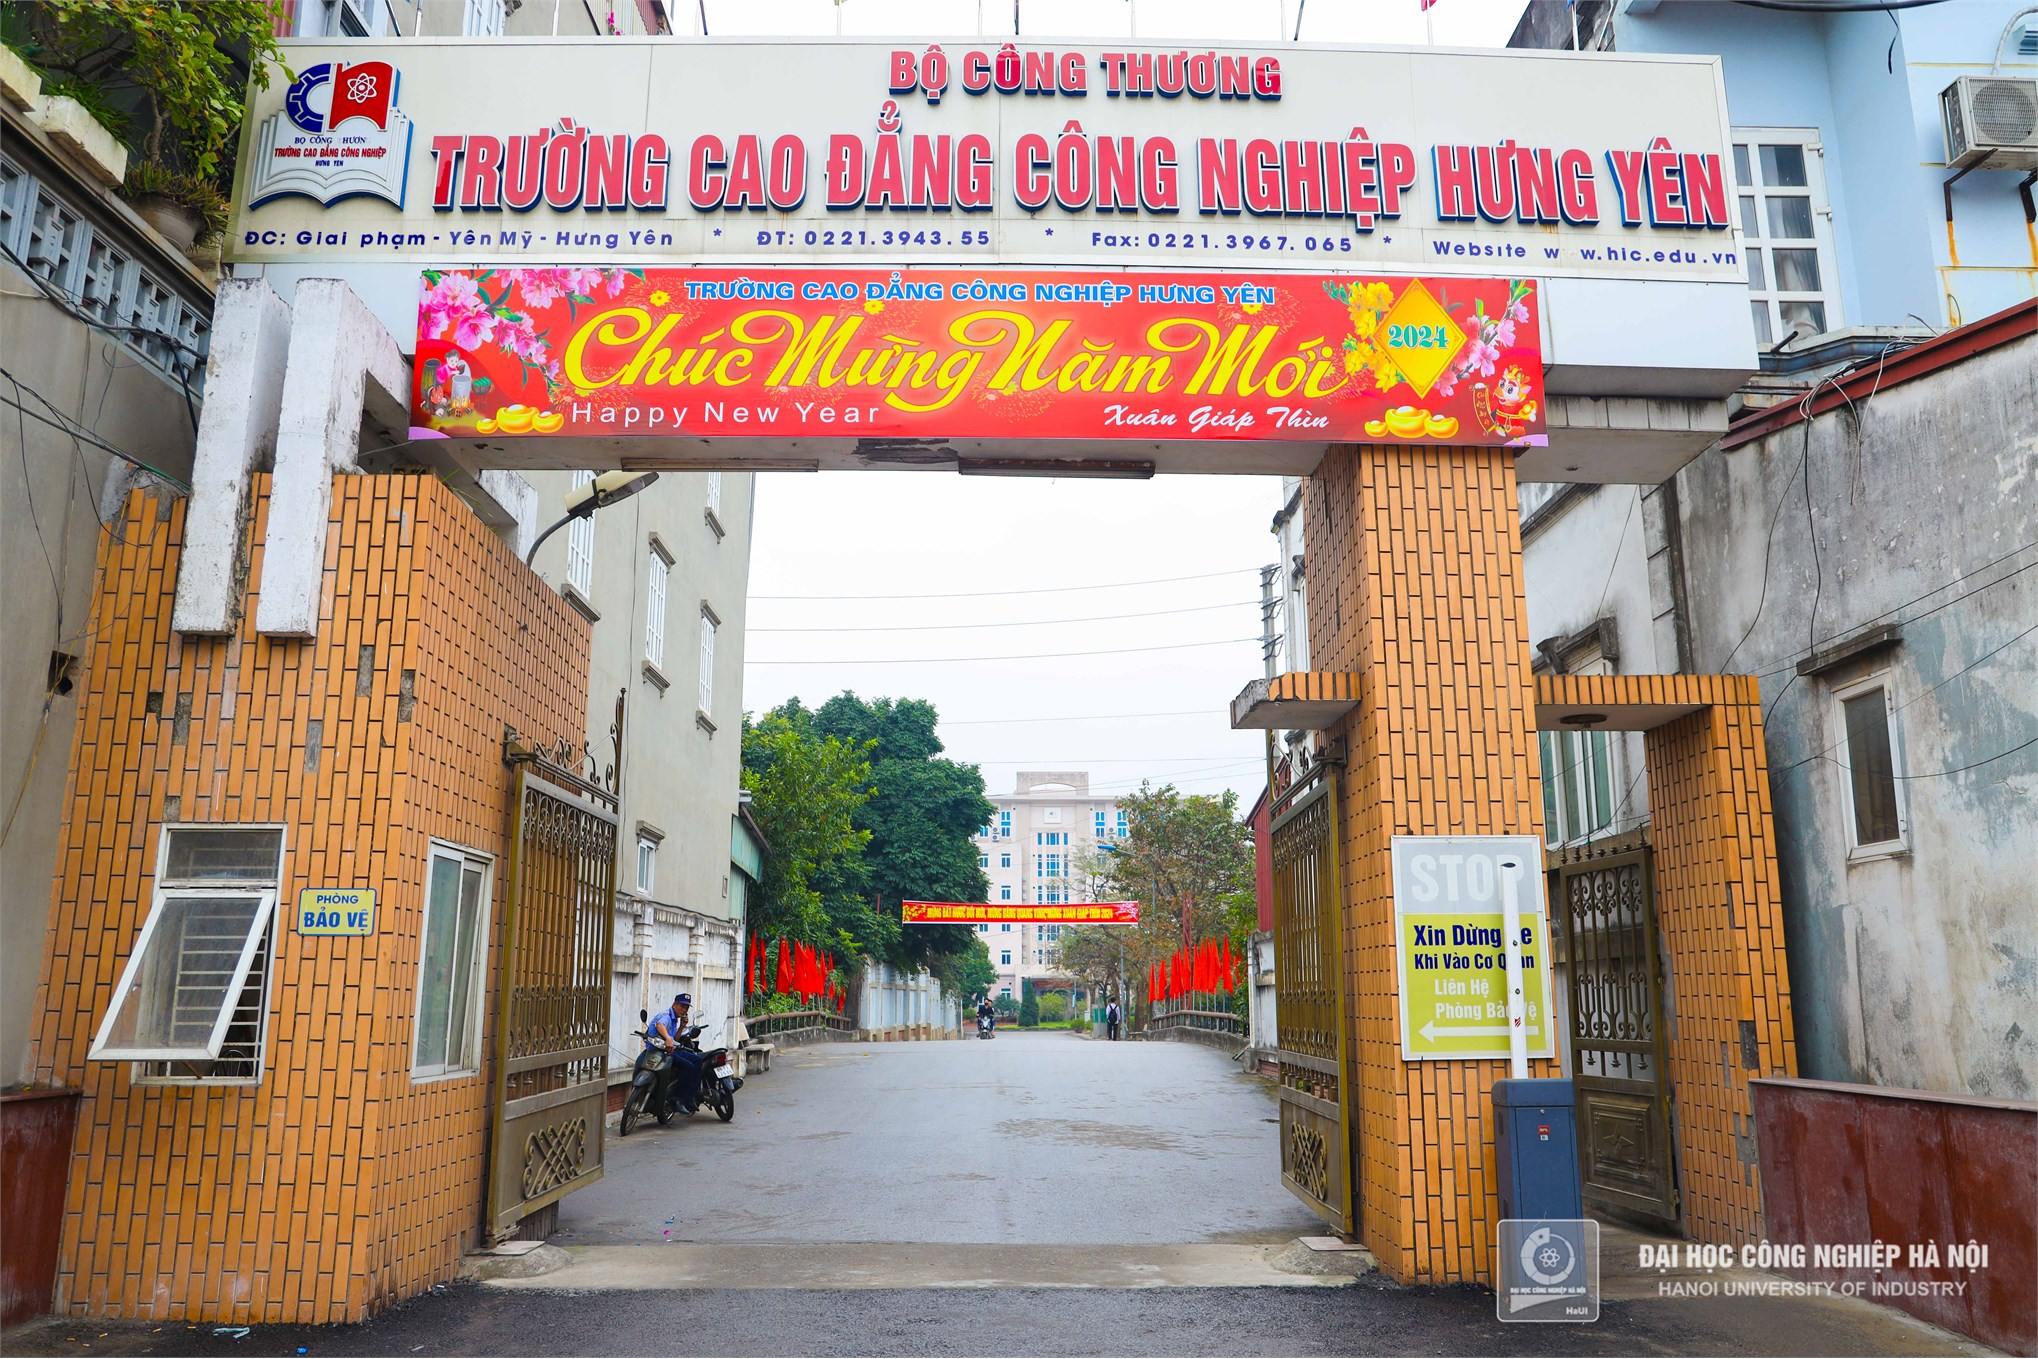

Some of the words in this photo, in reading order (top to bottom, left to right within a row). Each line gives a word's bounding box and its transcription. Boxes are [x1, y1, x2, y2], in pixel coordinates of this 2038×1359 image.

[889, 44, 948, 104] BỘ
[962, 43, 1088, 96] CÔNG
[1100, 50, 1282, 100] THƯƠNG
[303, 147, 318, 157] CAO
[341, 147, 360, 157] CÔNG
[361, 146, 386, 160] NGHIỆP
[431, 116, 671, 212] TRƯỜNG
[687, 133, 809, 212] CAO
[824, 100, 994, 212] ĐẲNG
[1013, 120, 1179, 213] CÔNG
[1195, 126, 1417, 234] NGHIỆP
[1431, 139, 1600, 226] HƯNG
[1606, 137, 1729, 230] YÊN
[244, 230, 286, 246] ĐC:
[296, 231, 348, 246] Giai
[360, 231, 426, 250] phạm
[449, 229, 492, 246] Yên
[499, 231, 533, 249] Mỹ
[556, 231, 619, 249] Hưng
[629, 229, 673, 246] Yên
[757, 231, 794, 246] ĐT:
[1092, 232, 1140, 247] Fax:
[685, 277, 794, 300] TRƯỜNG
[802, 282, 859, 301] CAO
[866, 272, 943, 301] ĐẲNG
[951, 279, 1032, 302] CÔNG
[1035, 281, 1131, 307] NGHIỆP
[1139, 283, 1214, 304] HƯNG
[1222, 282, 1275, 305] YÊN
[1387, 323, 1448, 349] 2024
[564, 307, 754, 390] Chúc
[730, 309, 985, 413] Mừng
[948, 309, 1174, 394] Năm
[1146, 318, 1350, 400] Mới
[572, 402, 688, 427] Happy
[704, 402, 781, 423] New
[795, 402, 880, 423] Year
[1104, 404, 1177, 427] Xuân
[1189, 405, 1255, 433] Giáp
[1266, 406, 1330, 428] Thìn
[1410, 854, 1524, 902] STOP
[316, 892, 359, 904] PHÒNG
[304, 906, 341, 928] BẢO
[347, 909, 369, 931] VỆ
[1414, 925, 1446, 946] Xin
[1452, 924, 1501, 948] Dừng
[1414, 953, 1438, 970] Khi
[1443, 952, 1470, 970] Vào
[1474, 953, 1493, 970] Cơ
[1435, 978, 1466, 995] Liên
[1470, 978, 1489, 998] Hệ
[1435, 1002, 1482, 1020] Phòng
